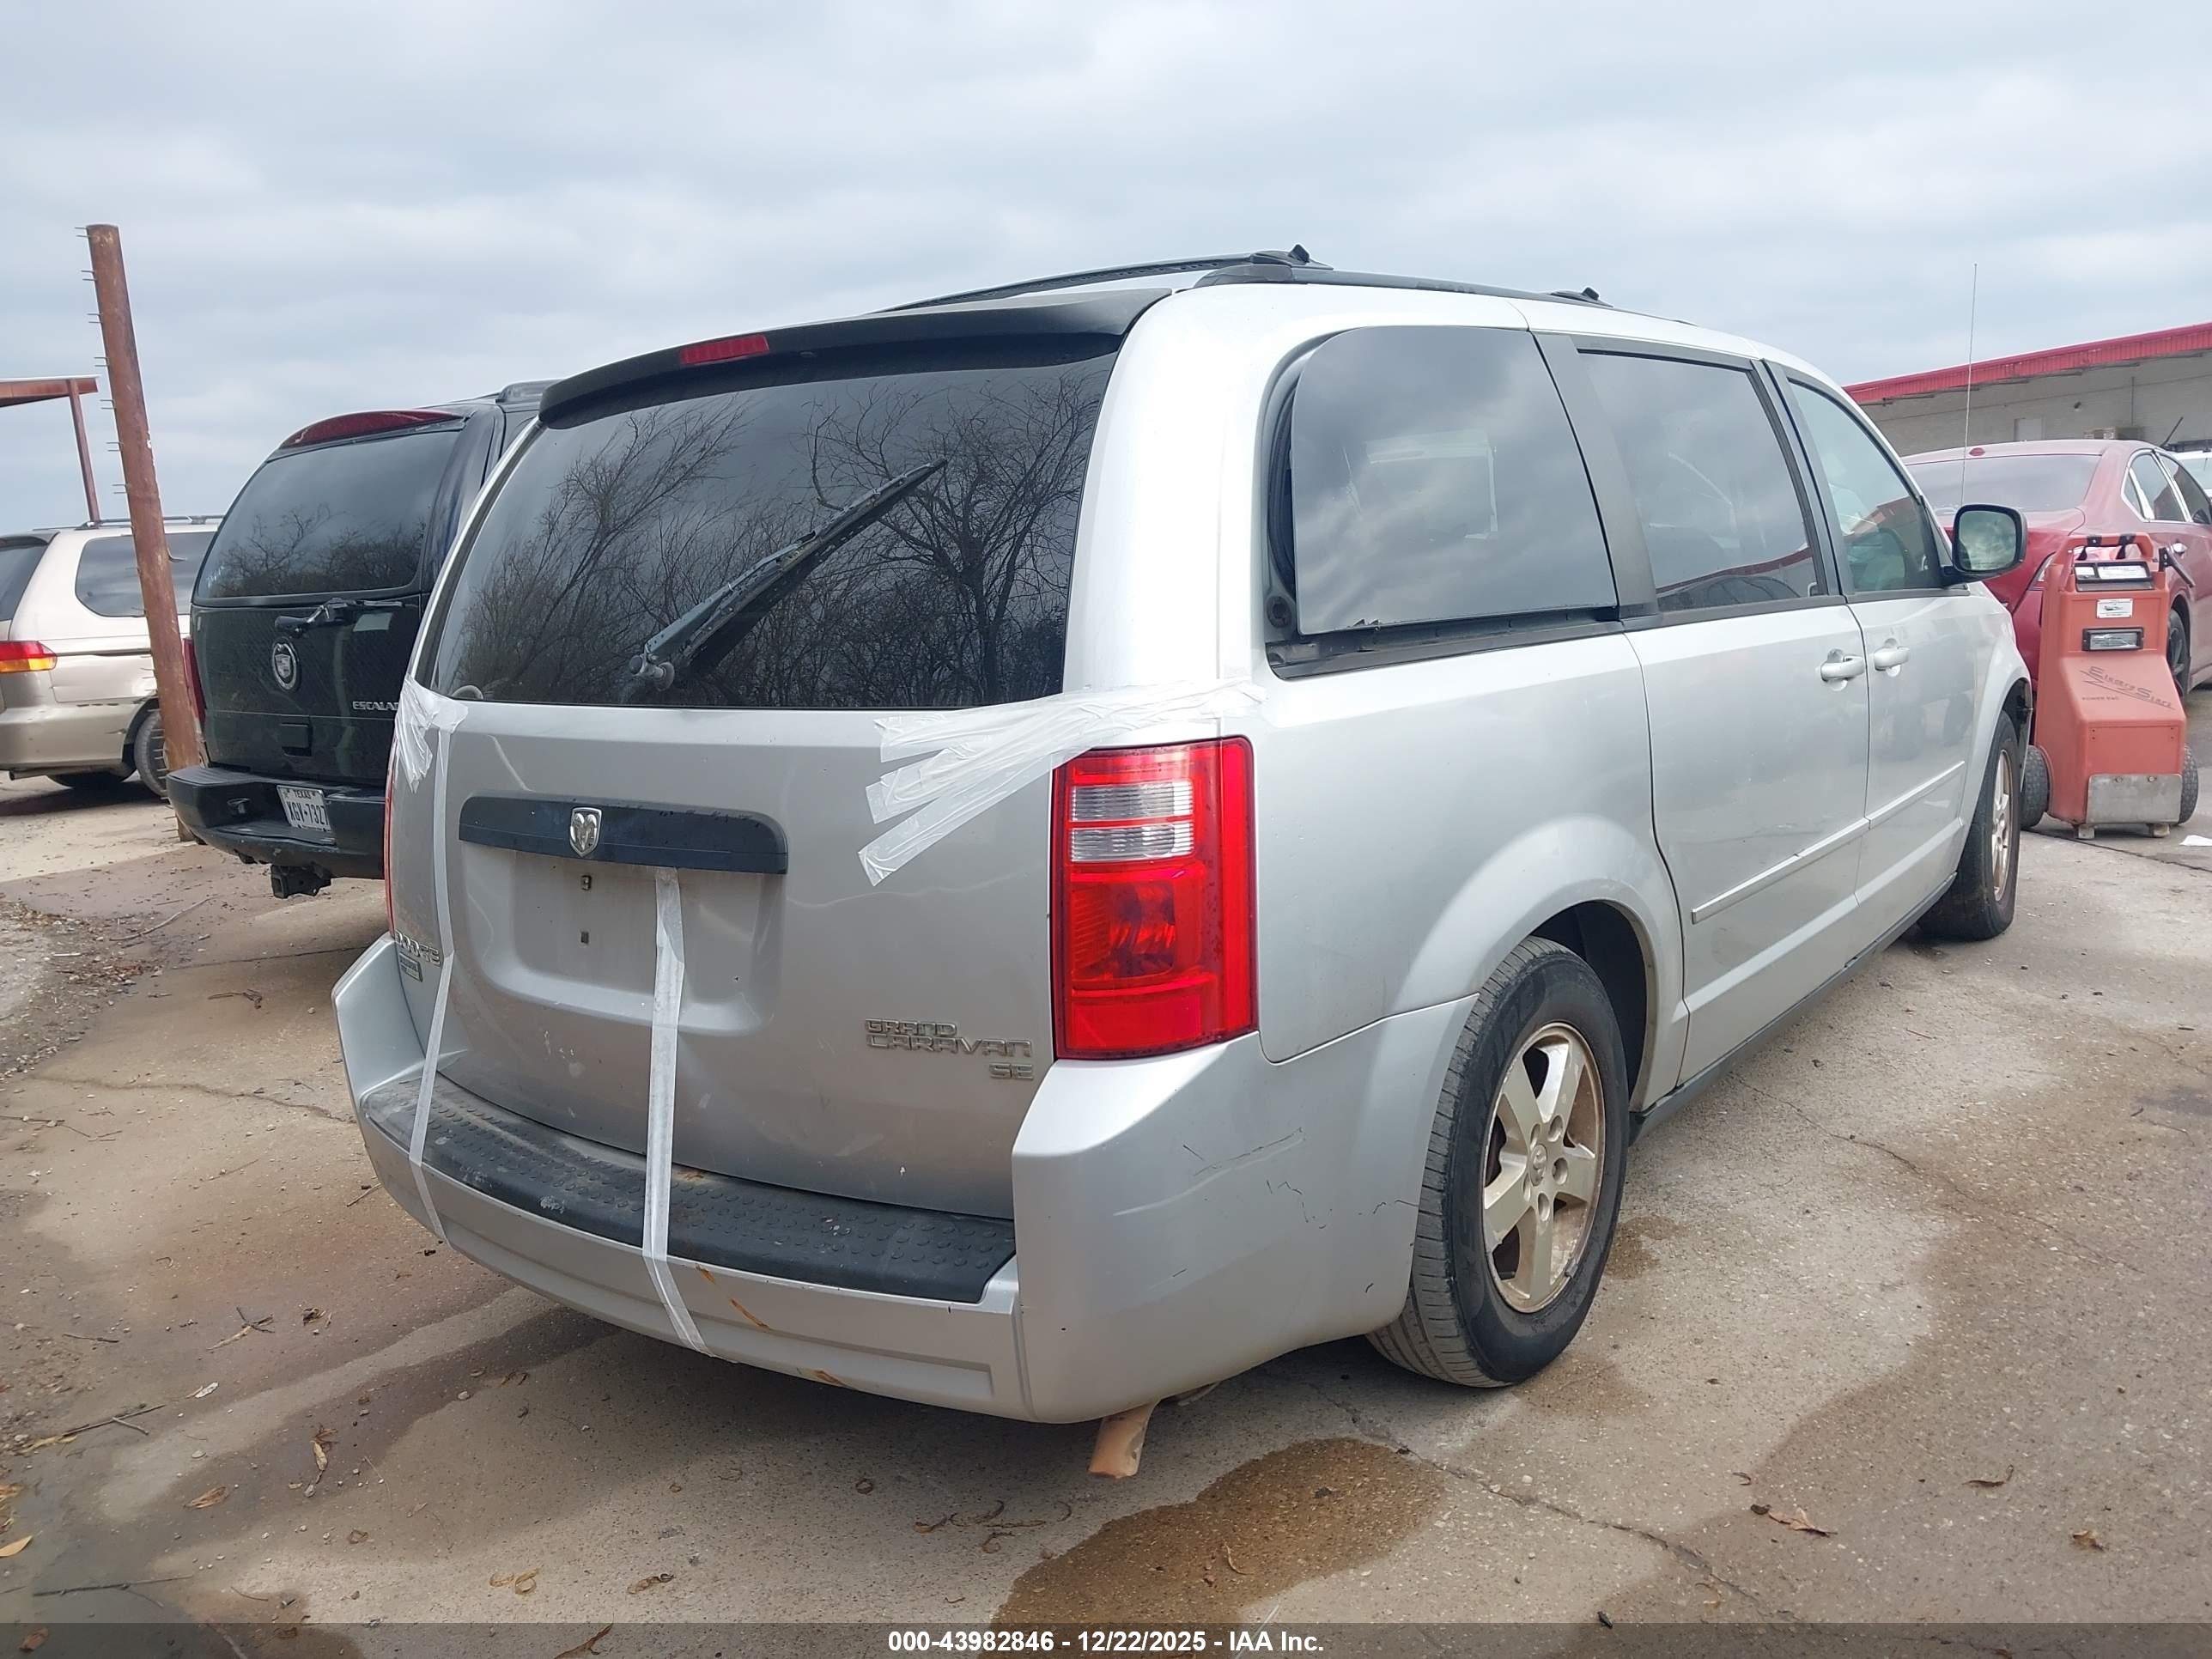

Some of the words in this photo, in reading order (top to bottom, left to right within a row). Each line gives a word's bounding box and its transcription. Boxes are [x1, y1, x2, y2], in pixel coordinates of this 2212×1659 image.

[865, 1018, 957, 1037] GRAND
[866, 1033, 1032, 1057] CARAVAN
[989, 1062, 1033, 1080] SE
